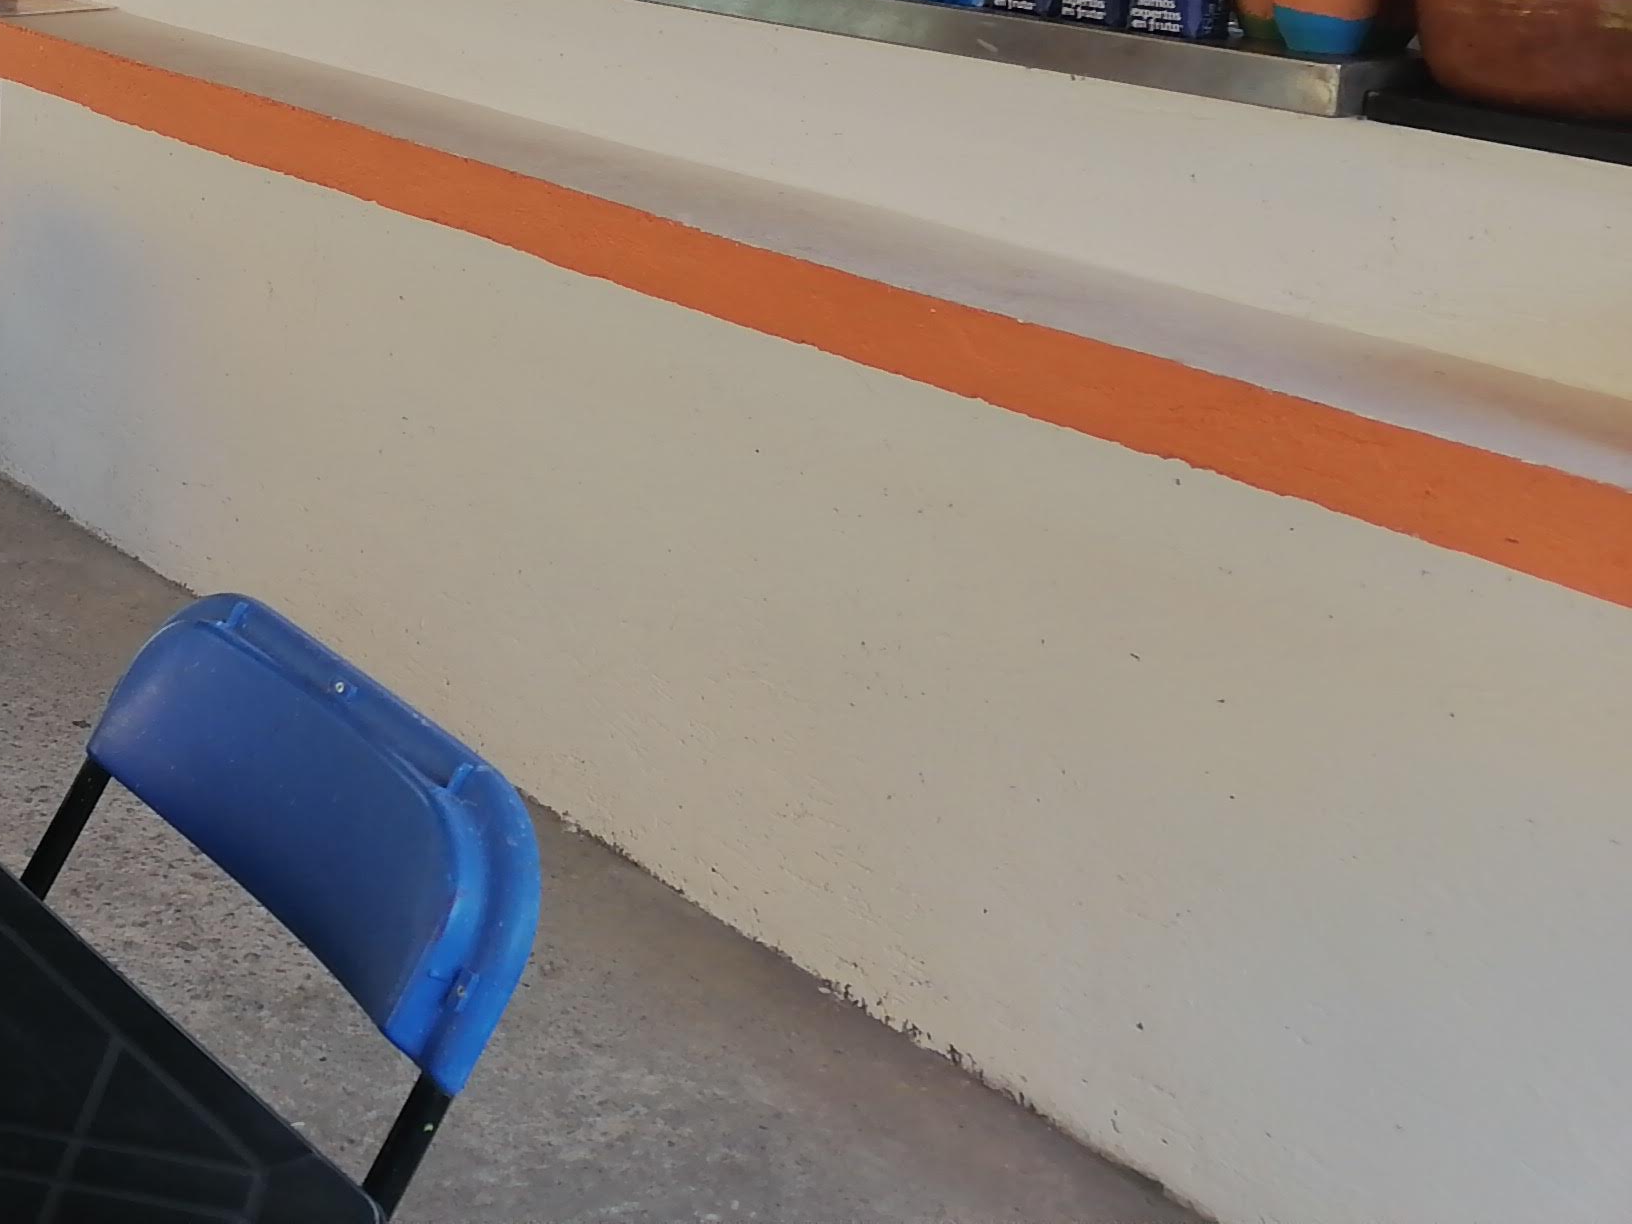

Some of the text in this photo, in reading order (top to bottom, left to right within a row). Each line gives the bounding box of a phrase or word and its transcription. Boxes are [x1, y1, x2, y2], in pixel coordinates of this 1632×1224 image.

[1130, 8, 1182, 21] expertos
[1131, 18, 1183, 32] en fruta
